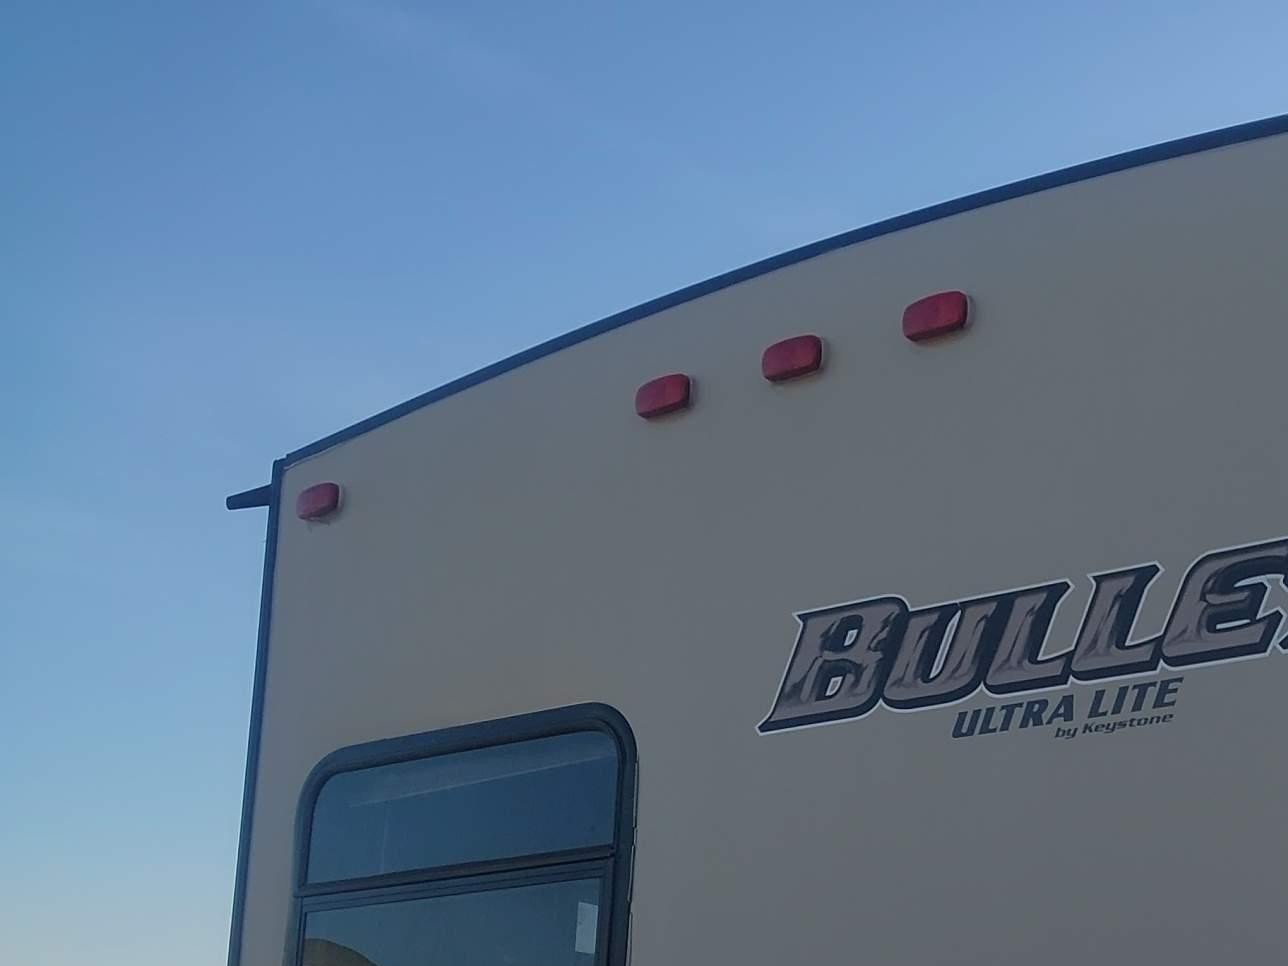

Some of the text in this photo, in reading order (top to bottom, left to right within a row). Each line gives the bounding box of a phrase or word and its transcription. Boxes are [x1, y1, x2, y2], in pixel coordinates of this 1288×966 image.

[951, 676, 1184, 739] ULTRA LITE
[1054, 712, 1174, 740] by Keystone
